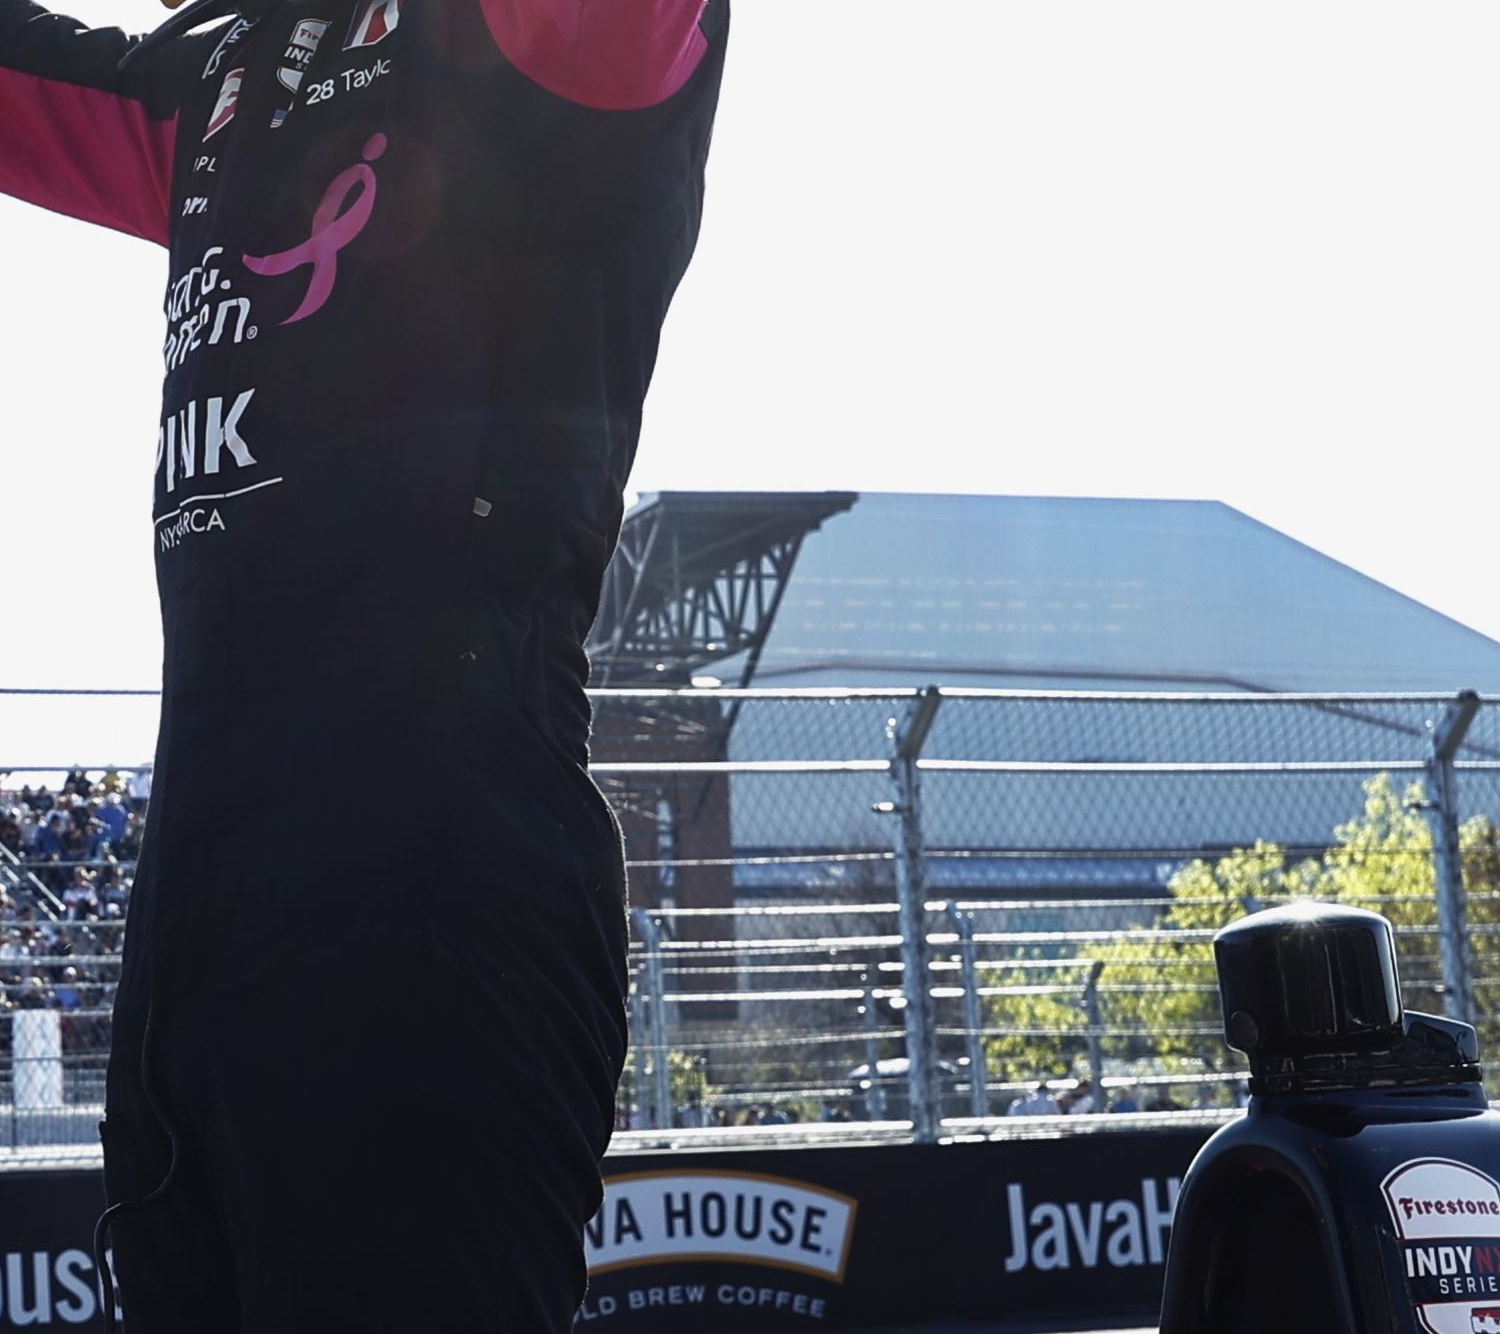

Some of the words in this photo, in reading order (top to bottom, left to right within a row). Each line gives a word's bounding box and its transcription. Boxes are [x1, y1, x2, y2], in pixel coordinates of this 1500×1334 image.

[306, 79, 335, 105] 28
[663, 1190, 828, 1254] HOUSE
[1004, 1177, 1181, 1273] JavaH
[1398, 1196, 1500, 1220] Firestone
[628, 1284, 706, 1311] BREW
[716, 1284, 827, 1319] COFFEE
